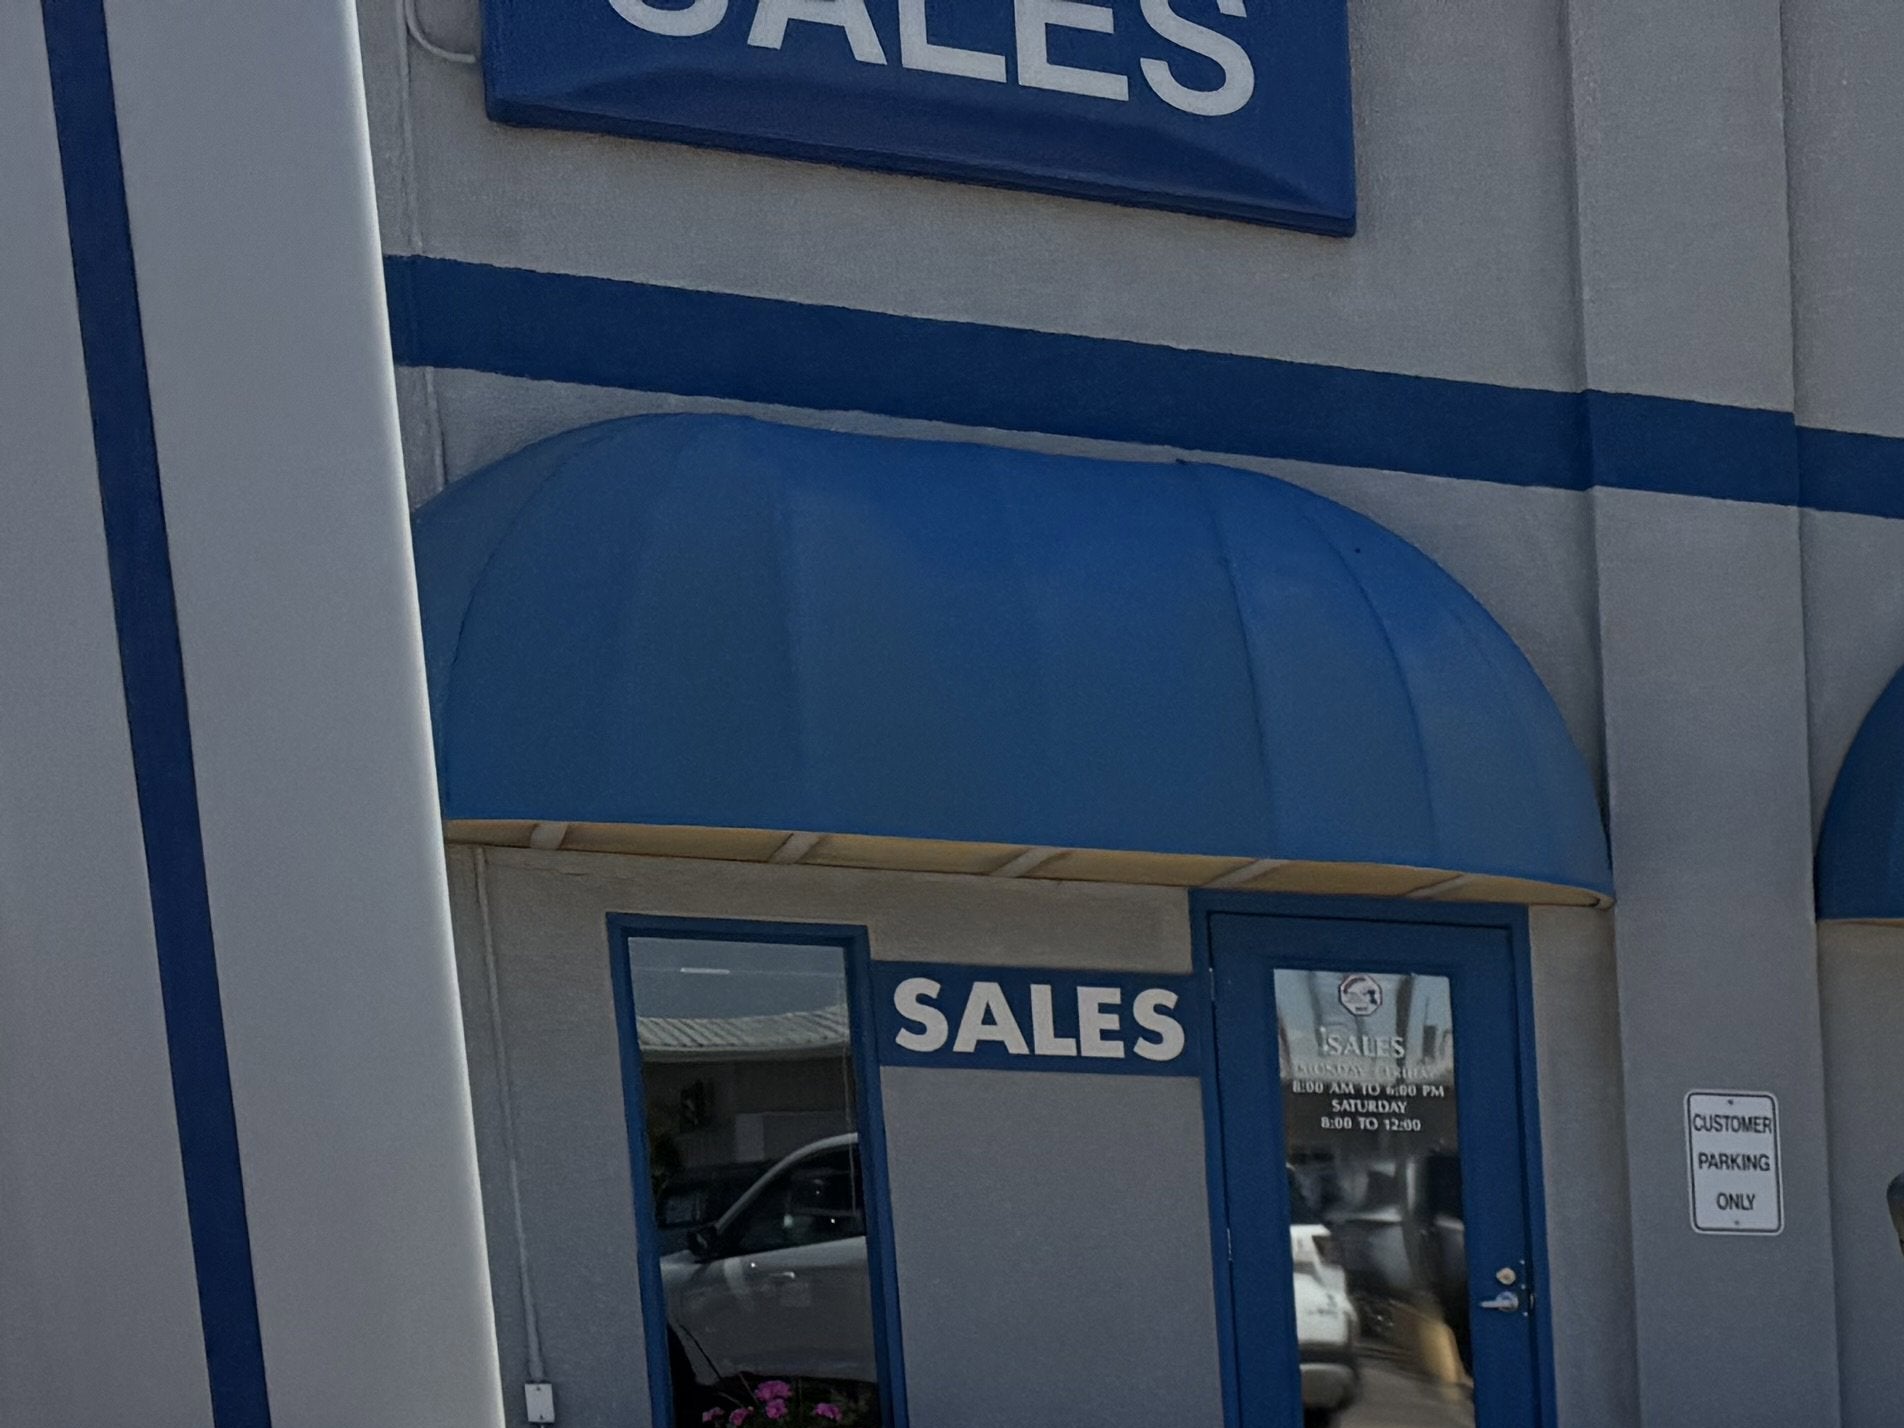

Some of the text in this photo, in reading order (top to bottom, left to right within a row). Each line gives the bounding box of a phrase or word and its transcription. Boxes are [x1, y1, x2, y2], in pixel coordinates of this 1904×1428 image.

[892, 976, 1186, 1062] SALES
[1327, 1034, 1405, 1059] SALES
[1329, 1082, 1355, 1095] AM
[1361, 1083, 1380, 1096] TO
[1422, 1085, 1445, 1098] PM
[1331, 1098, 1408, 1114] SATURDAY
[1320, 1117, 1422, 1132] 8:00 TO 12:00
[1692, 1113, 1773, 1134] CUSTOMER
[1698, 1152, 1771, 1172] PARKING
[1716, 1192, 1756, 1211] ONLY
